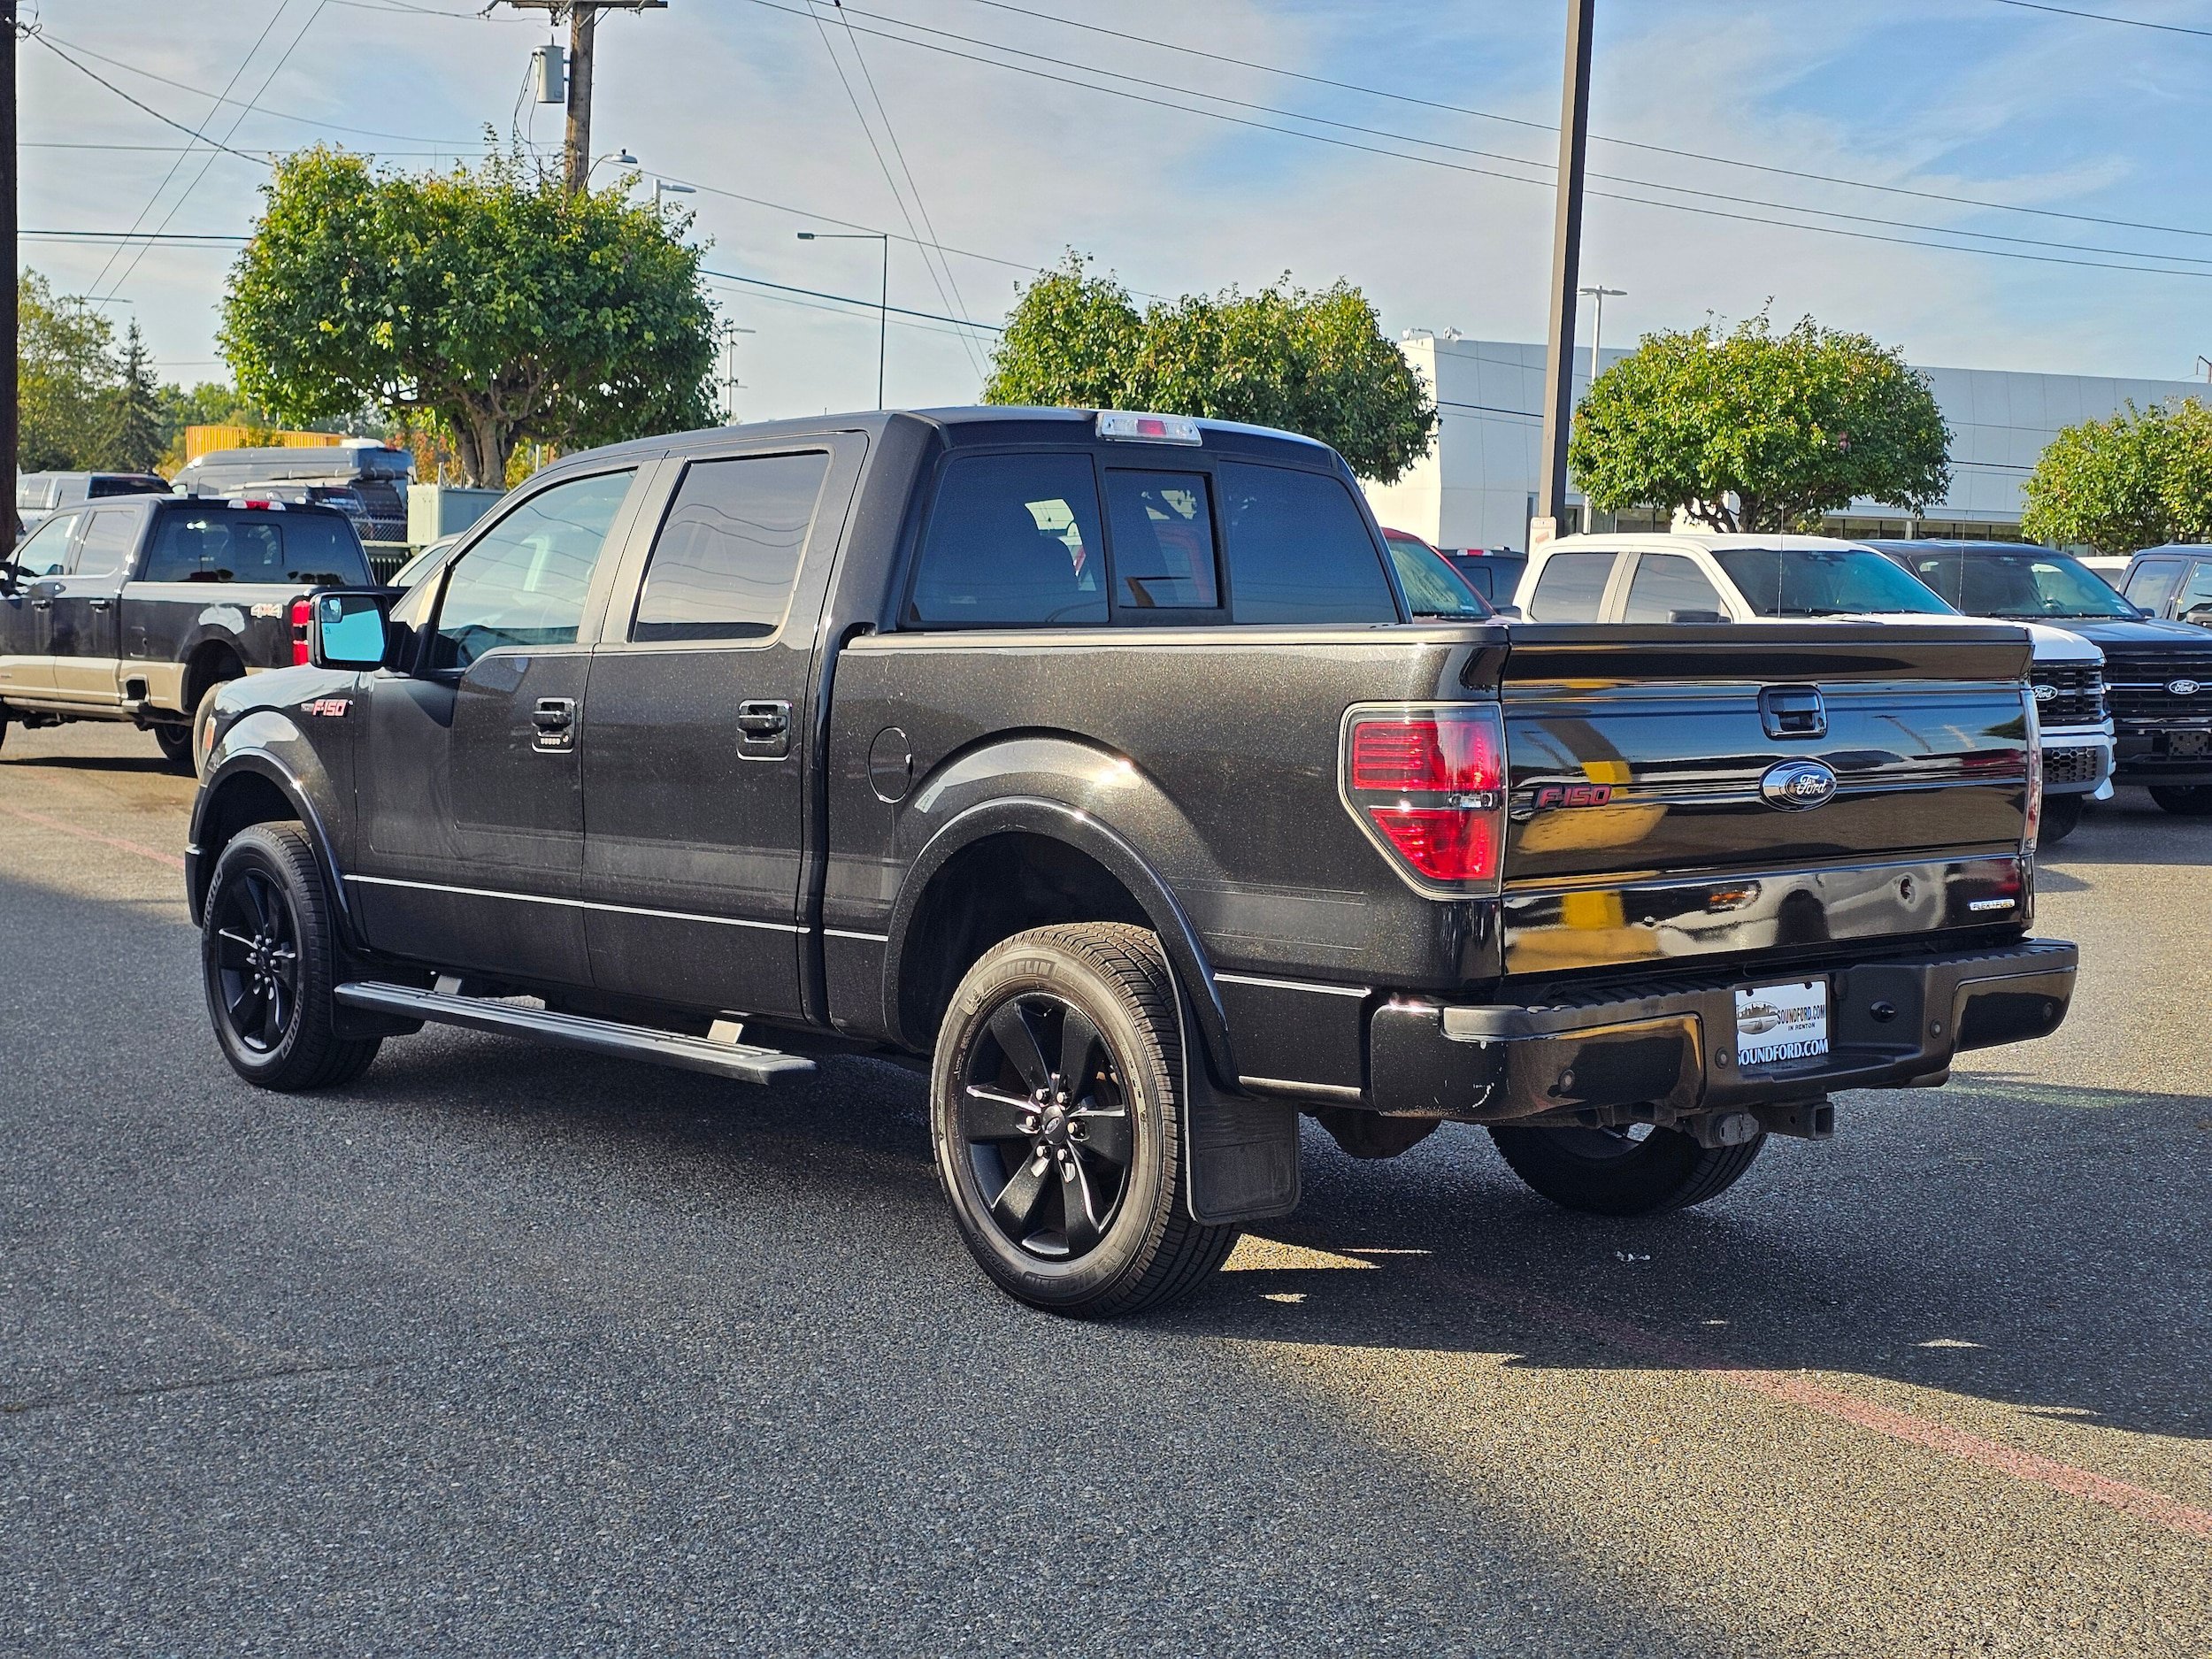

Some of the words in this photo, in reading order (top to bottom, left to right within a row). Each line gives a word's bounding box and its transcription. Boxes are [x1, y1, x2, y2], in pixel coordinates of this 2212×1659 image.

[2034, 687, 2053, 699] Ford
[2175, 681, 2194, 692] Ford
[311, 699, 349, 716] F-150
[1795, 773, 1827, 795] Ford
[1537, 784, 1612, 808] F-150
[1777, 1004, 1825, 1025] SOUNDFORD.COM
[1794, 1022, 1816, 1031] RENTON
